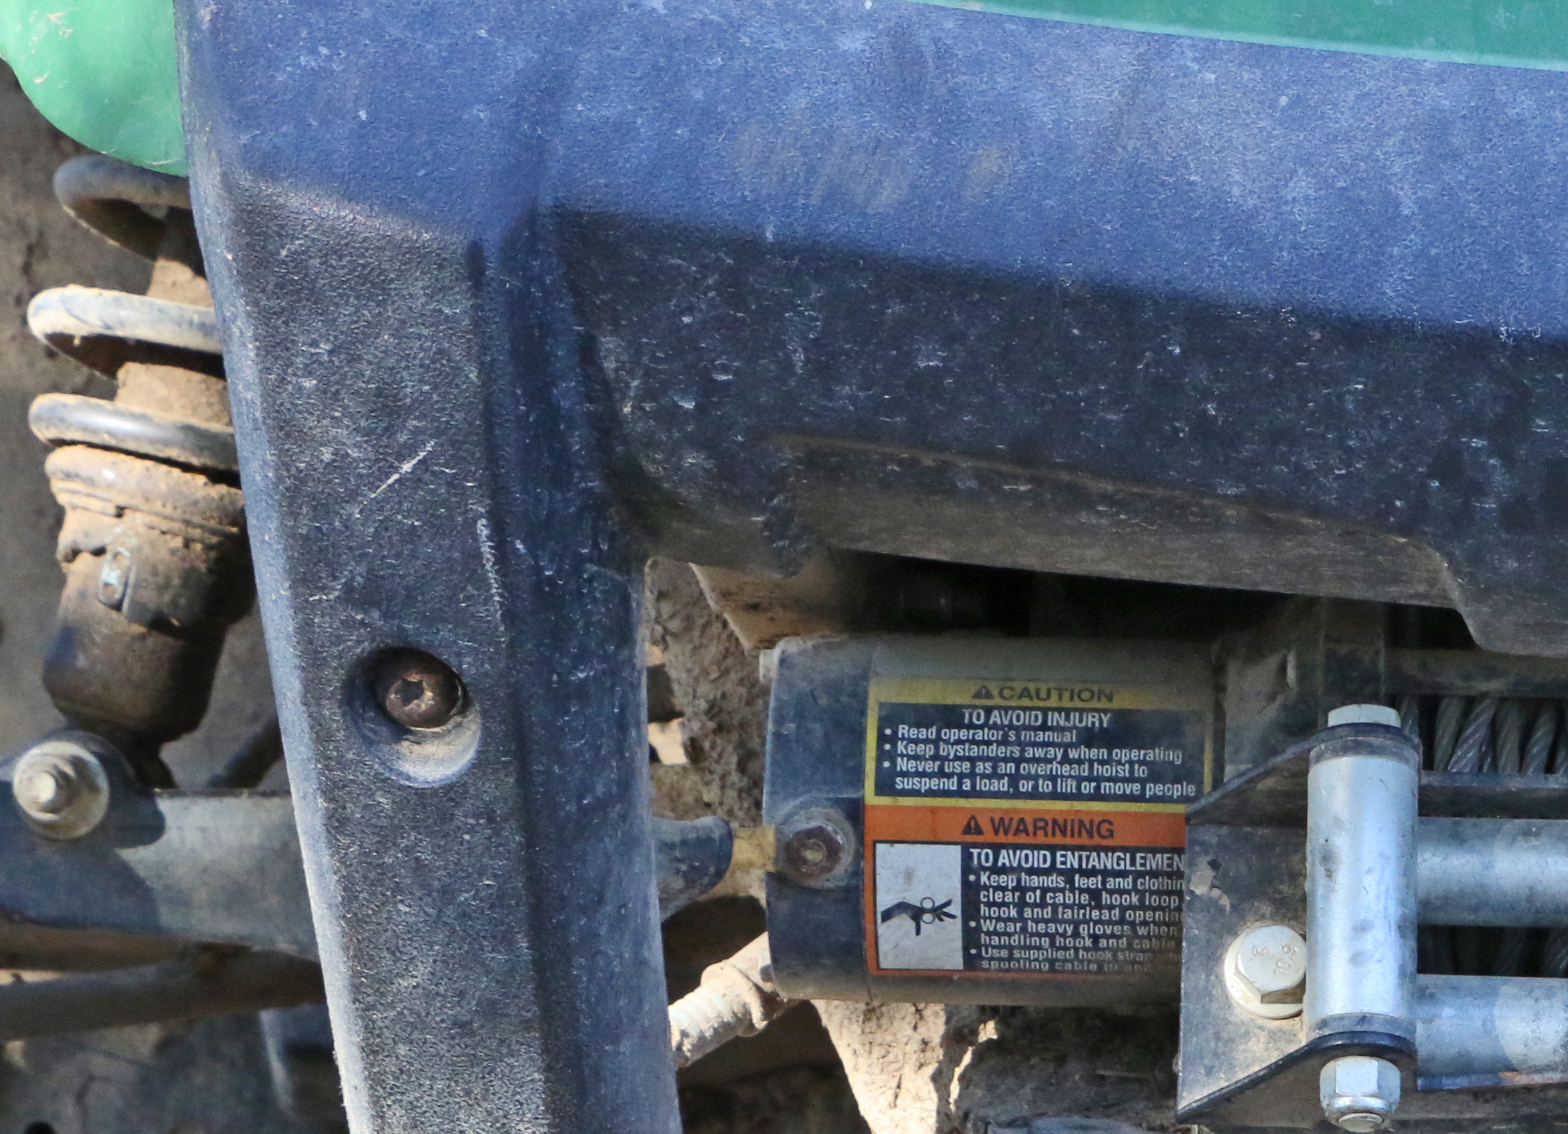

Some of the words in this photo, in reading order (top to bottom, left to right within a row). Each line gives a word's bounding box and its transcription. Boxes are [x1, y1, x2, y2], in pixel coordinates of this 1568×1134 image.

[998, 686, 1114, 702] CAUTION
[962, 709, 985, 725] TO
[989, 710, 1042, 726] AVOID
[1047, 711, 1111, 728] INJURY
[898, 725, 936, 739] Read
[941, 727, 1016, 742] operator's
[1021, 730, 1076, 742] manual
[897, 740, 934, 758] Keep
[940, 742, 1020, 759] bystanders
[1025, 747, 1063, 761] away
[1068, 745, 1107, 760] when
[1112, 747, 1182, 764] operating
[896, 757, 940, 772] Never
[944, 760, 970, 773] use
[975, 762, 992, 774] as
[997, 763, 1015, 774] an
[1020, 761, 1088, 776] overhead
[1093, 762, 1129, 777] hoist
[1134, 764, 1148, 777] to
[895, 775, 957, 792] suspend
[962, 779, 971, 790] a
[976, 776, 1013, 793] load,
[1019, 780, 1033, 792] or
[1038, 779, 1052, 792] to
[1057, 778, 1076, 793] lift
[1081, 781, 1096, 793] or
[1100, 783, 1141, 795] move
[1146, 781, 1196, 798] people
[990, 816, 1115, 839] WARNING
[969, 848, 993, 867] TO
[998, 849, 1050, 868] AVOID
[1056, 851, 1185, 871] ENTANGLEMEN
[980, 871, 1016, 889] Keep
[1021, 872, 1069, 889] hands,
[1074, 873, 1102, 888] feet
[1106, 875, 1132, 889] and
[1137, 875, 1184, 890] clothin
[980, 888, 1020, 902] clear
[1025, 889, 1041, 903] of
[1046, 890, 1095, 906] cable,
[1101, 891, 1140, 906] hook
[1145, 892, 1179, 909] loop
[980, 903, 1018, 918] hook
[1023, 905, 1052, 918] and
[1058, 906, 1119, 920] fairlead
[1125, 908, 1184, 923] openin
[980, 919, 1022, 932] Wear
[1027, 920, 1074, 936] heavy
[1080, 922, 1132, 937] gloves
[1136, 923, 1177, 936] when
[981, 933, 1050, 948] handling
[1056, 935, 1093, 948] hook
[1098, 937, 1127, 948] and
[1133, 938, 1175, 949] cable
[981, 946, 1009, 958] Use
[1013, 948, 1075, 960] supplied
[1078, 949, 1114, 960] hook
